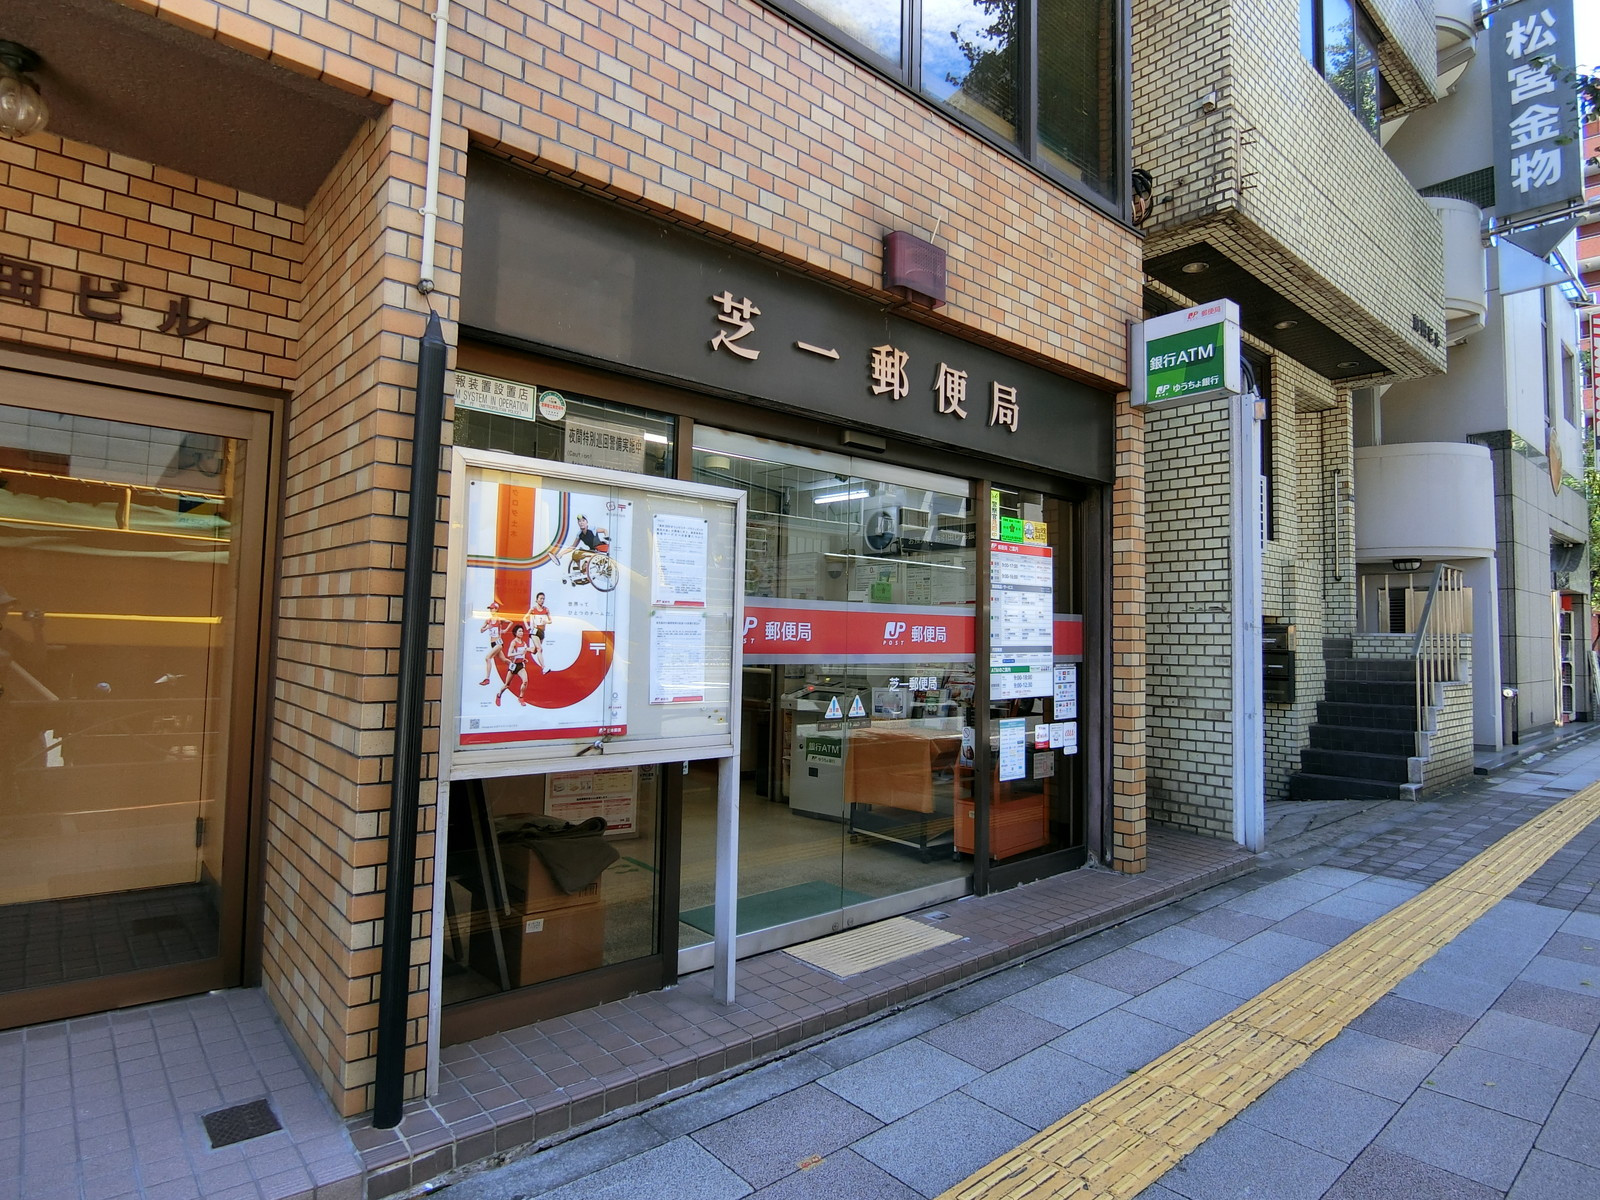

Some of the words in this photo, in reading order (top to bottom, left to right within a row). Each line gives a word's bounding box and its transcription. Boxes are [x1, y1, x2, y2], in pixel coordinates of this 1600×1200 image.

[1505, 8, 1563, 194] 松宮金物
[711, 290, 1019, 433] 芝一郵便局
[1149, 343, 1213, 371] 銀行ATM
[1172, 375, 1220, 393] ゆうちょ銀行
[463, 390, 488, 404] SYSTEM
[490, 395, 497, 406] IN
[498, 397, 529, 413] OPERATION
[568, 428, 642, 454] 夜間特別巡回警備実施中
[764, 621, 812, 642] 郵便局
[911, 625, 946, 643] 郵便局
[888, 676, 938, 692] 芝一郵便局
